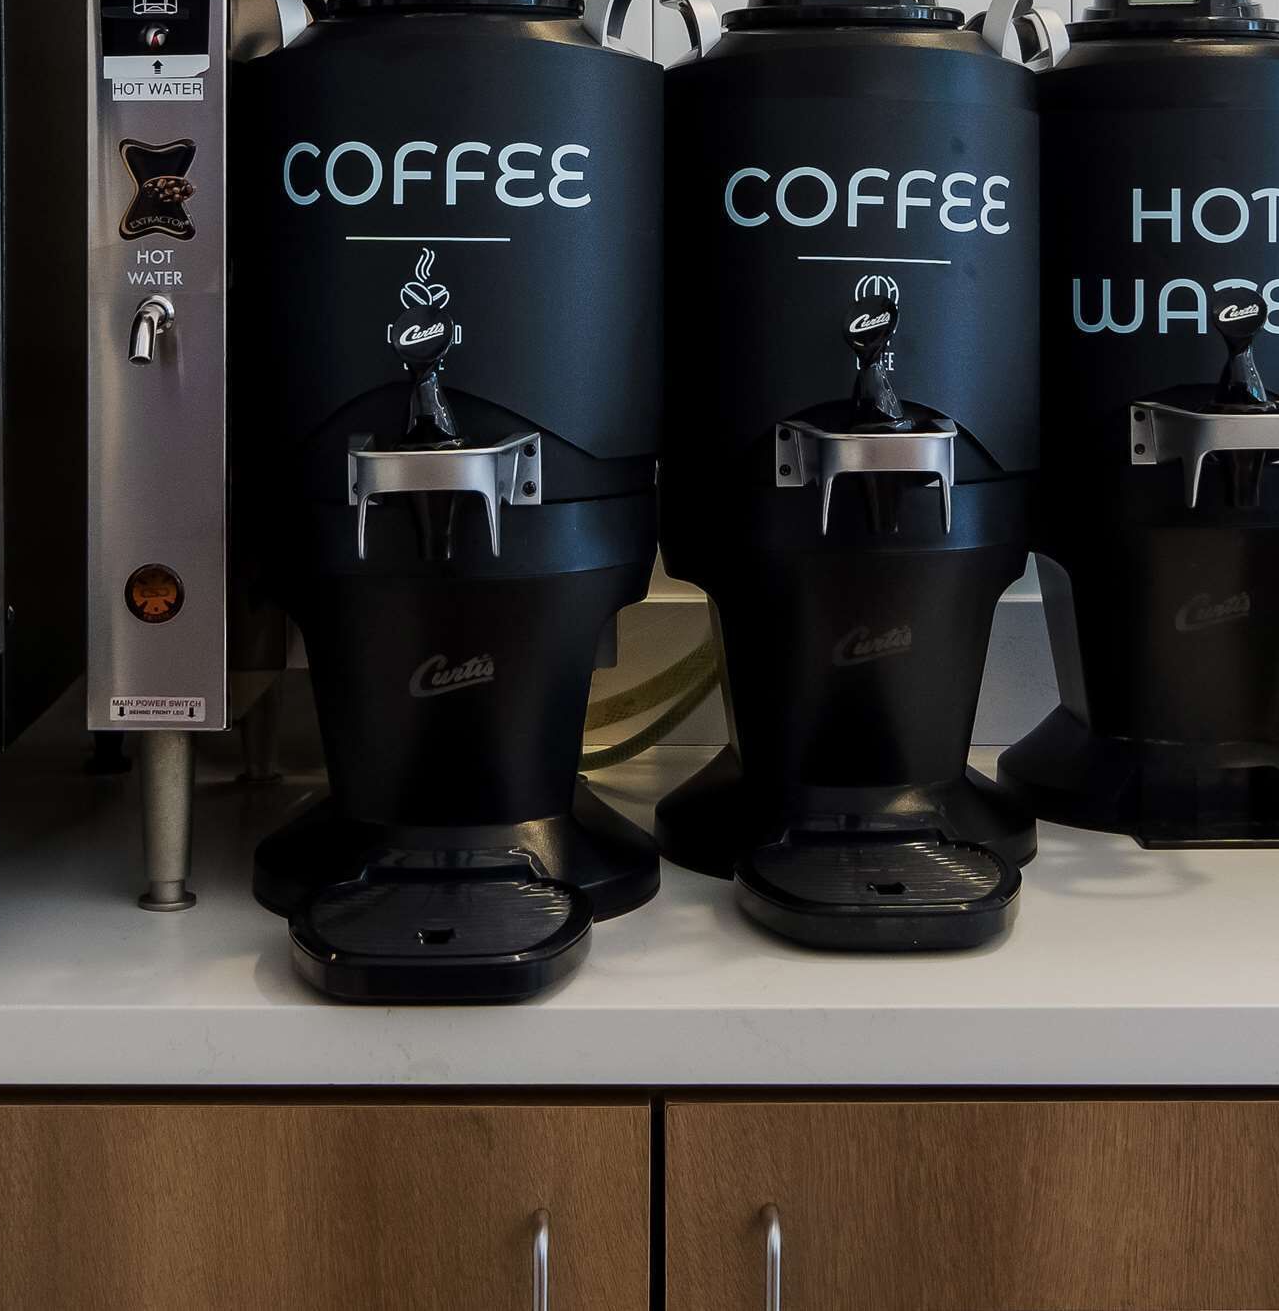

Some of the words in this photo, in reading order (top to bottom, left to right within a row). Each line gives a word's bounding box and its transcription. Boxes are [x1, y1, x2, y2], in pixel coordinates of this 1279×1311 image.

[113, 83, 144, 95] HOT
[148, 83, 202, 95] WATER
[283, 141, 591, 207] COFFEE
[724, 168, 1011, 236] COFFEE
[136, 249, 174, 265] HOT
[127, 272, 183, 286] WATER
